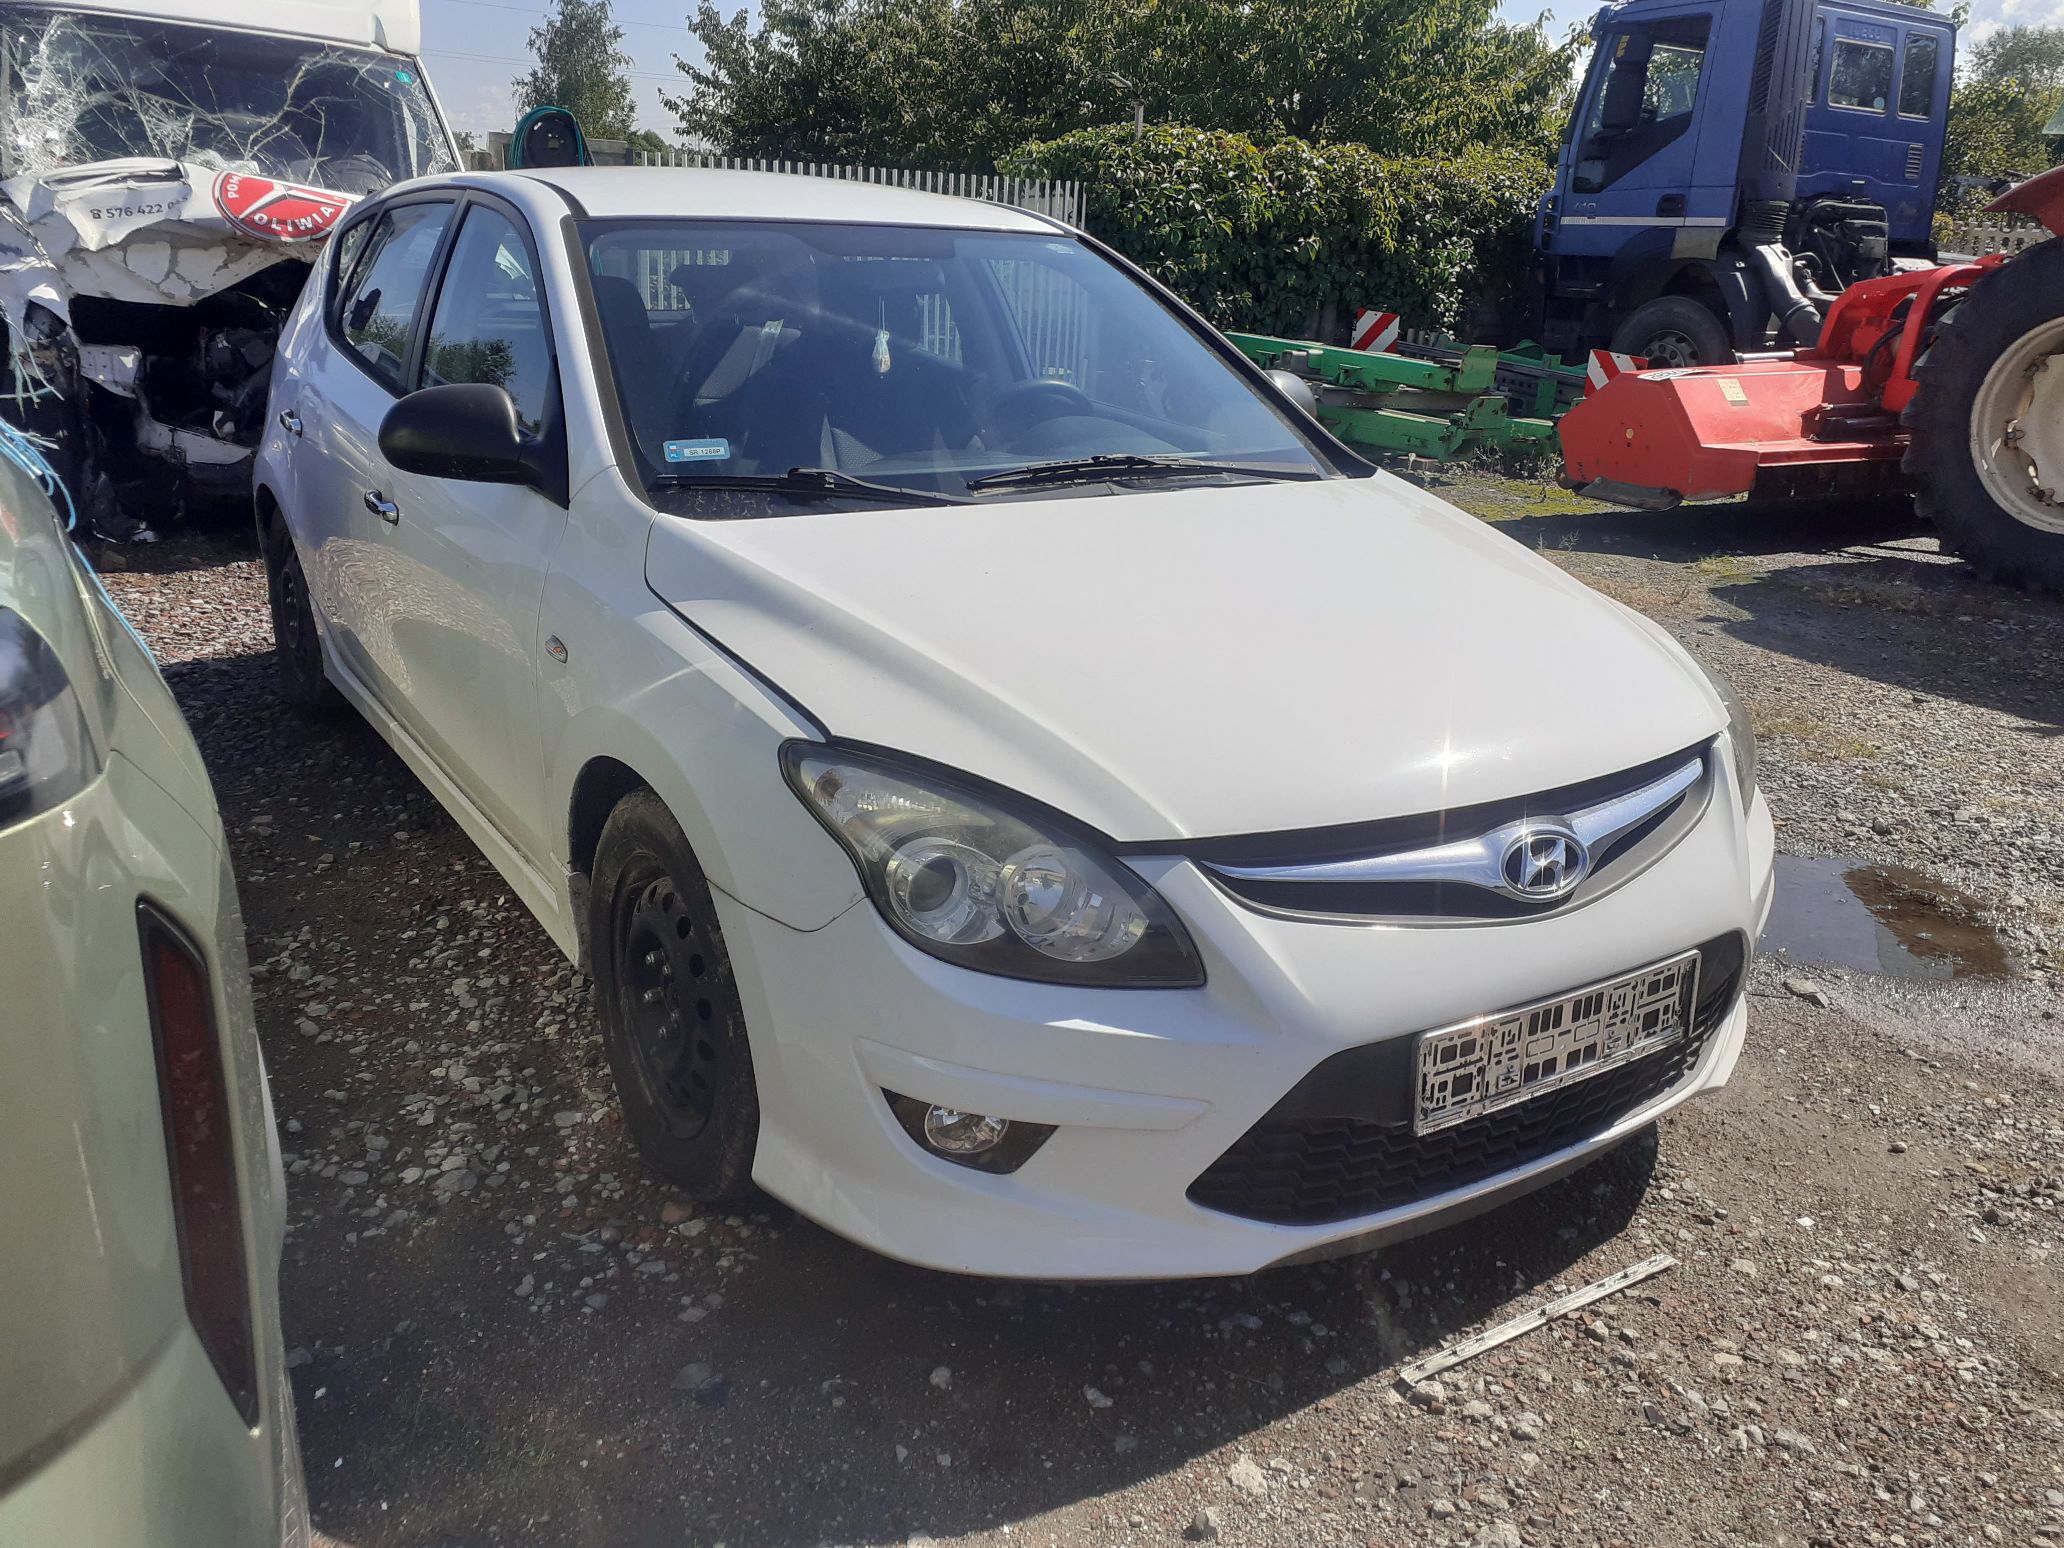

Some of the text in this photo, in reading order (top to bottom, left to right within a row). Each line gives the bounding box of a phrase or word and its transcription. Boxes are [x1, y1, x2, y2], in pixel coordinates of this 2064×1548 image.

[106, 203, 164, 219] 576 422
[253, 206, 336, 232] OLIWIA
